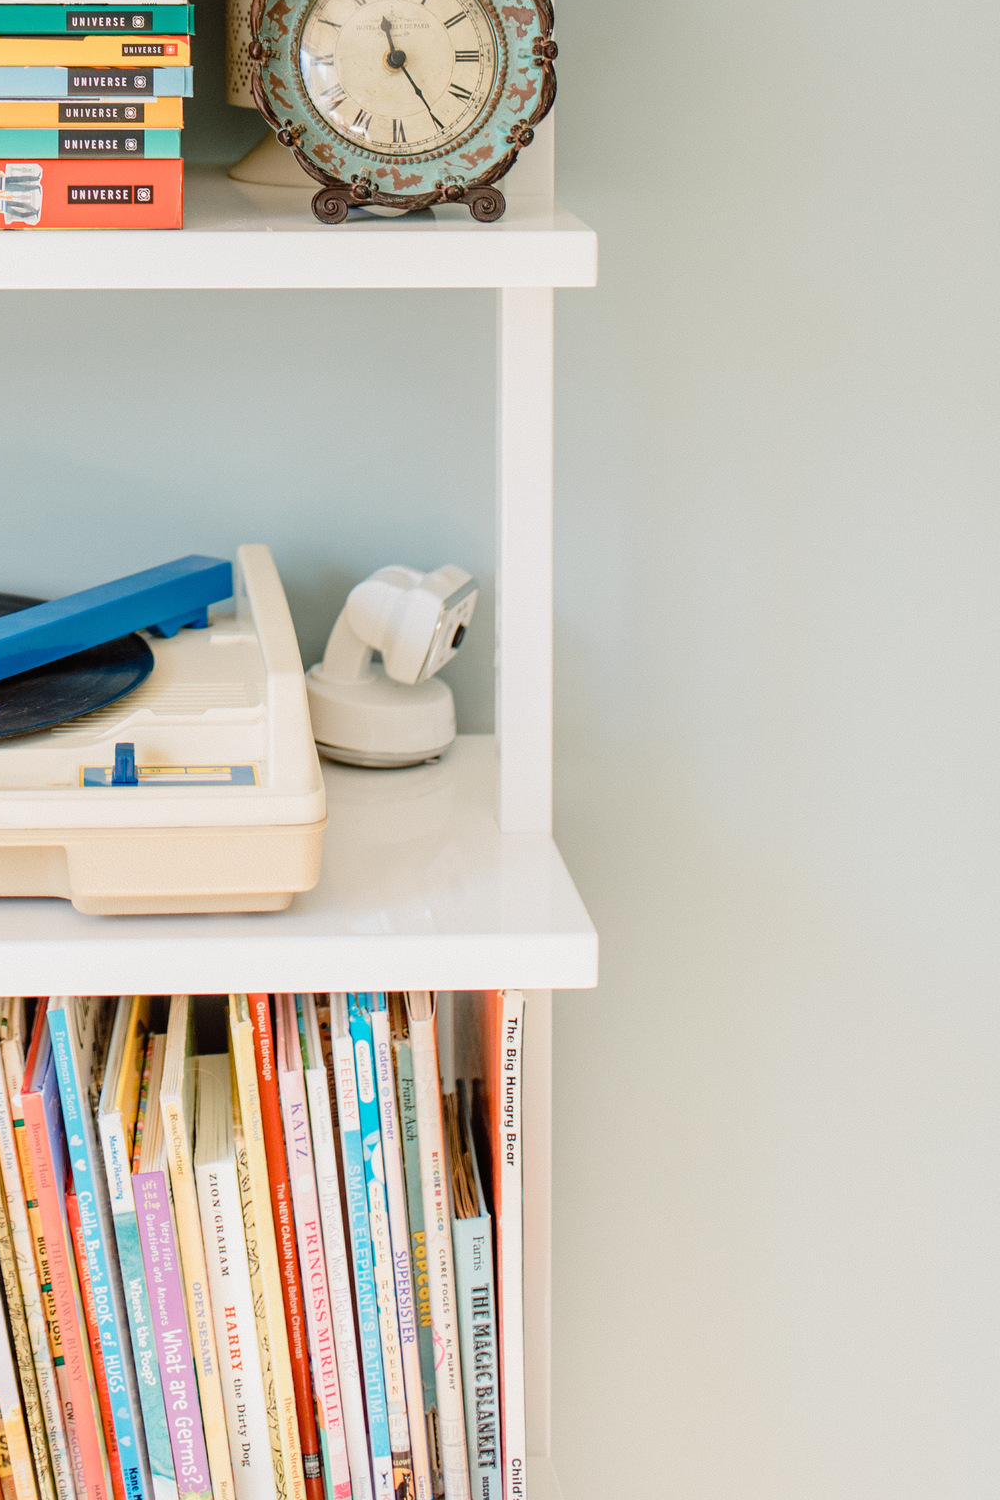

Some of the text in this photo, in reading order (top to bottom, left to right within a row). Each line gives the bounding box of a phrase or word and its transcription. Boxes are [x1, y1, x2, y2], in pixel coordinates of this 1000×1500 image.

[72, 17, 126, 27] UNIVERSE
[66, 108, 118, 118] UNIVERSE
[72, 190, 129, 200] UNIVERSE
[503, 1017, 517, 1166] The Big Hungry Bear
[78, 1191, 125, 1394] Cuddle Bear's BOOK of HUGS
[290, 1102, 341, 1431] KATZ PRINCESS MIREILLE
[162, 1329, 200, 1484] What are Germs?
[471, 1284, 496, 1469] THE MAGIC BLANKET
